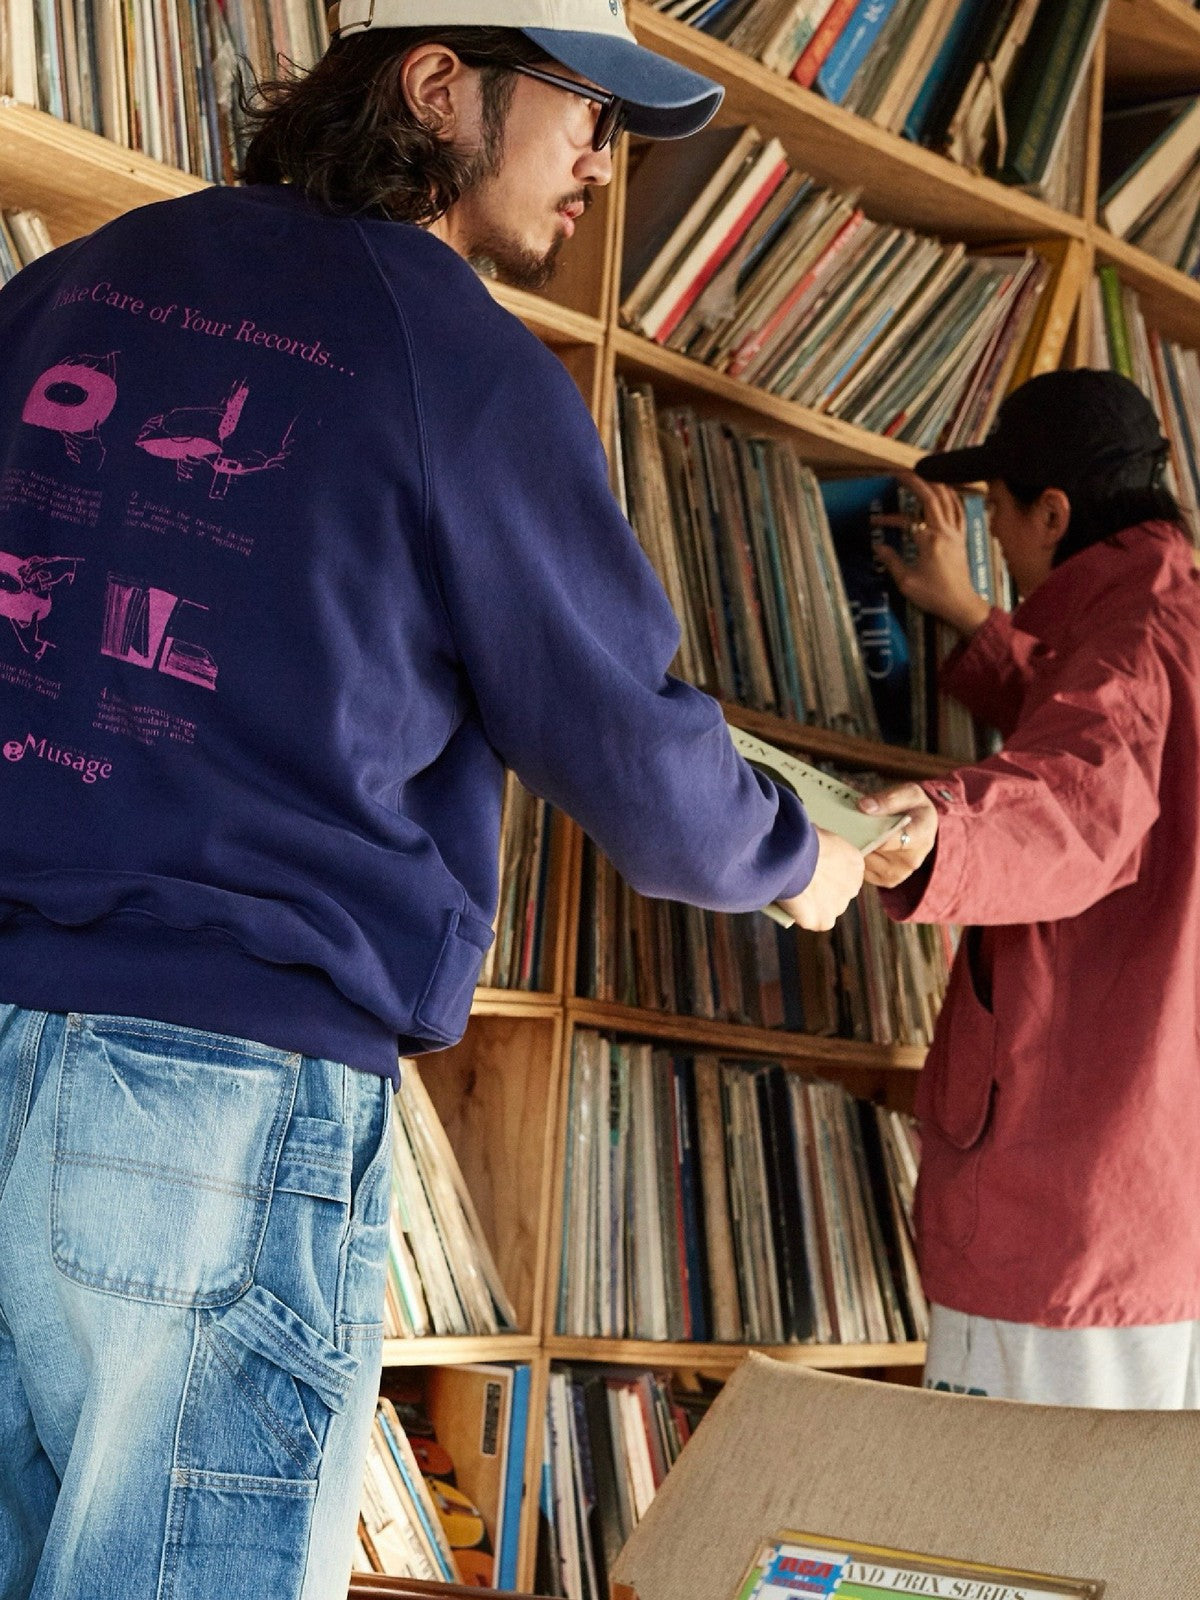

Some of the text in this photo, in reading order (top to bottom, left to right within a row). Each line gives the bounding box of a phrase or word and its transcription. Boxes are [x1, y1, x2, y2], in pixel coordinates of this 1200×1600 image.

[91, 281, 144, 314] Care
[149, 303, 178, 323] of
[181, 308, 232, 337] Your
[22, 733, 113, 784] Musage
[778, 1556, 834, 1578] RCA
[892, 1572, 943, 1593] PRIX
[949, 1580, 1028, 1600] SERIES
